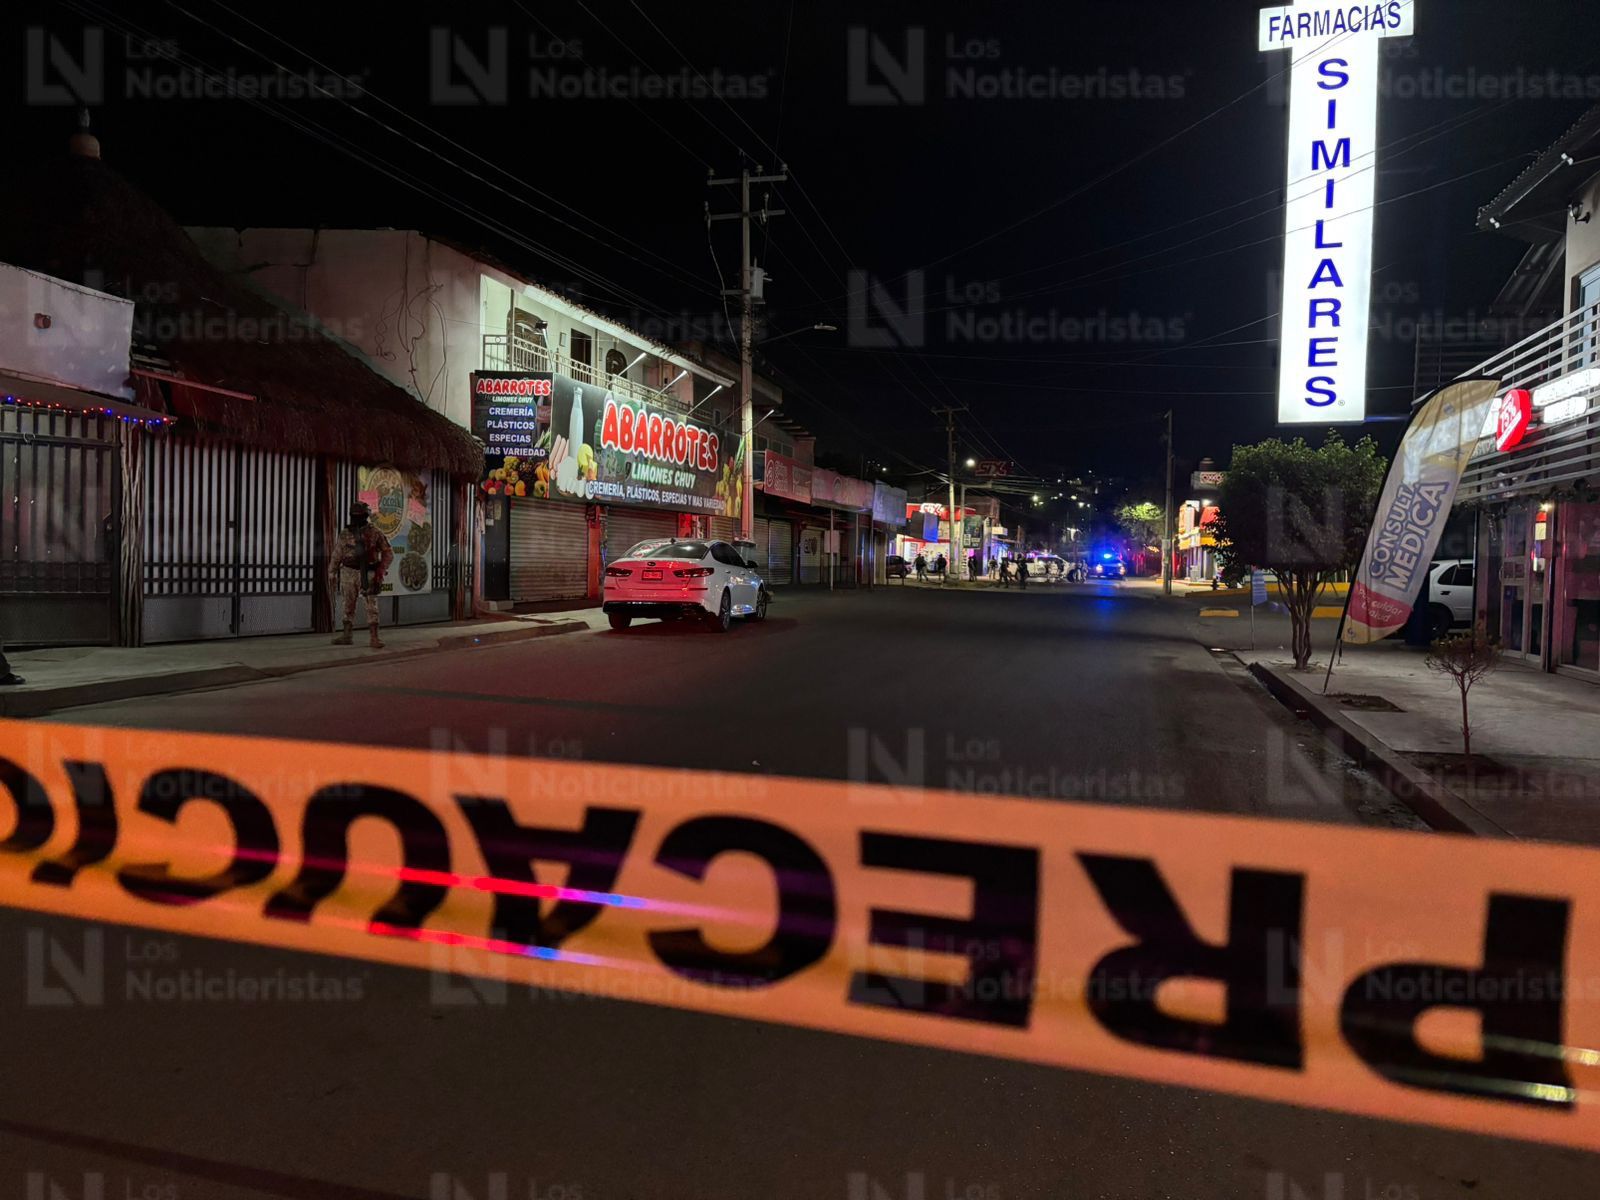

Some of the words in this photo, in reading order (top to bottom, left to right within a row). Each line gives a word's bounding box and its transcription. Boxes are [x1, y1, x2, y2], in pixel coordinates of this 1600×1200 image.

[1269, 1, 1401, 42] FARMACIAS
[1304, 58, 1351, 407] SIMILARES
[477, 378, 552, 396] ABARROTES
[488, 406, 534, 417] CREMERÍA
[487, 419, 535, 430] PLÁSTICOS
[489, 433, 532, 444] ESPECIAS
[601, 399, 719, 472] ABARROTES
[502, 447, 546, 456] VARIEDAD
[631, 462, 673, 485] LIMONES
[674, 470, 696, 489] CHUY
